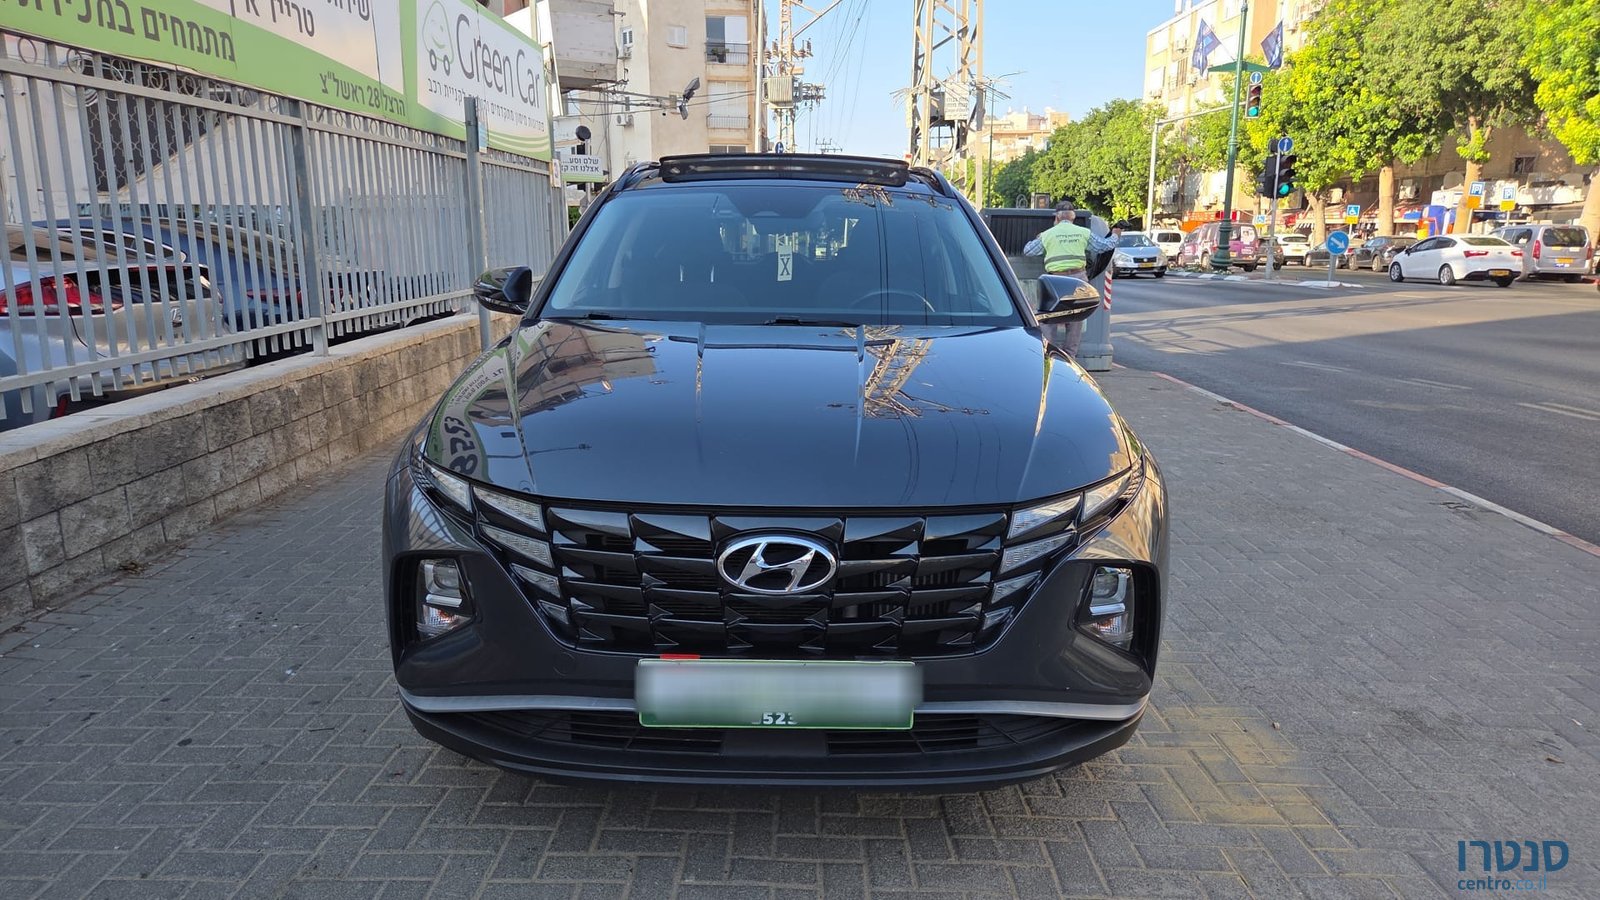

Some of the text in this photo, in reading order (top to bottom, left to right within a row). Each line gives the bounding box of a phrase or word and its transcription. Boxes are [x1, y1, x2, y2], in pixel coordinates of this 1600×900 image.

[141, 7, 236, 63] מתמחים
[456, 13, 540, 109] Green Car
[366, 85, 380, 109] 28
[382, 88, 405, 116] הרצל
[579, 164, 600, 173] אצלנו
[583, 156, 599, 164] שלם
